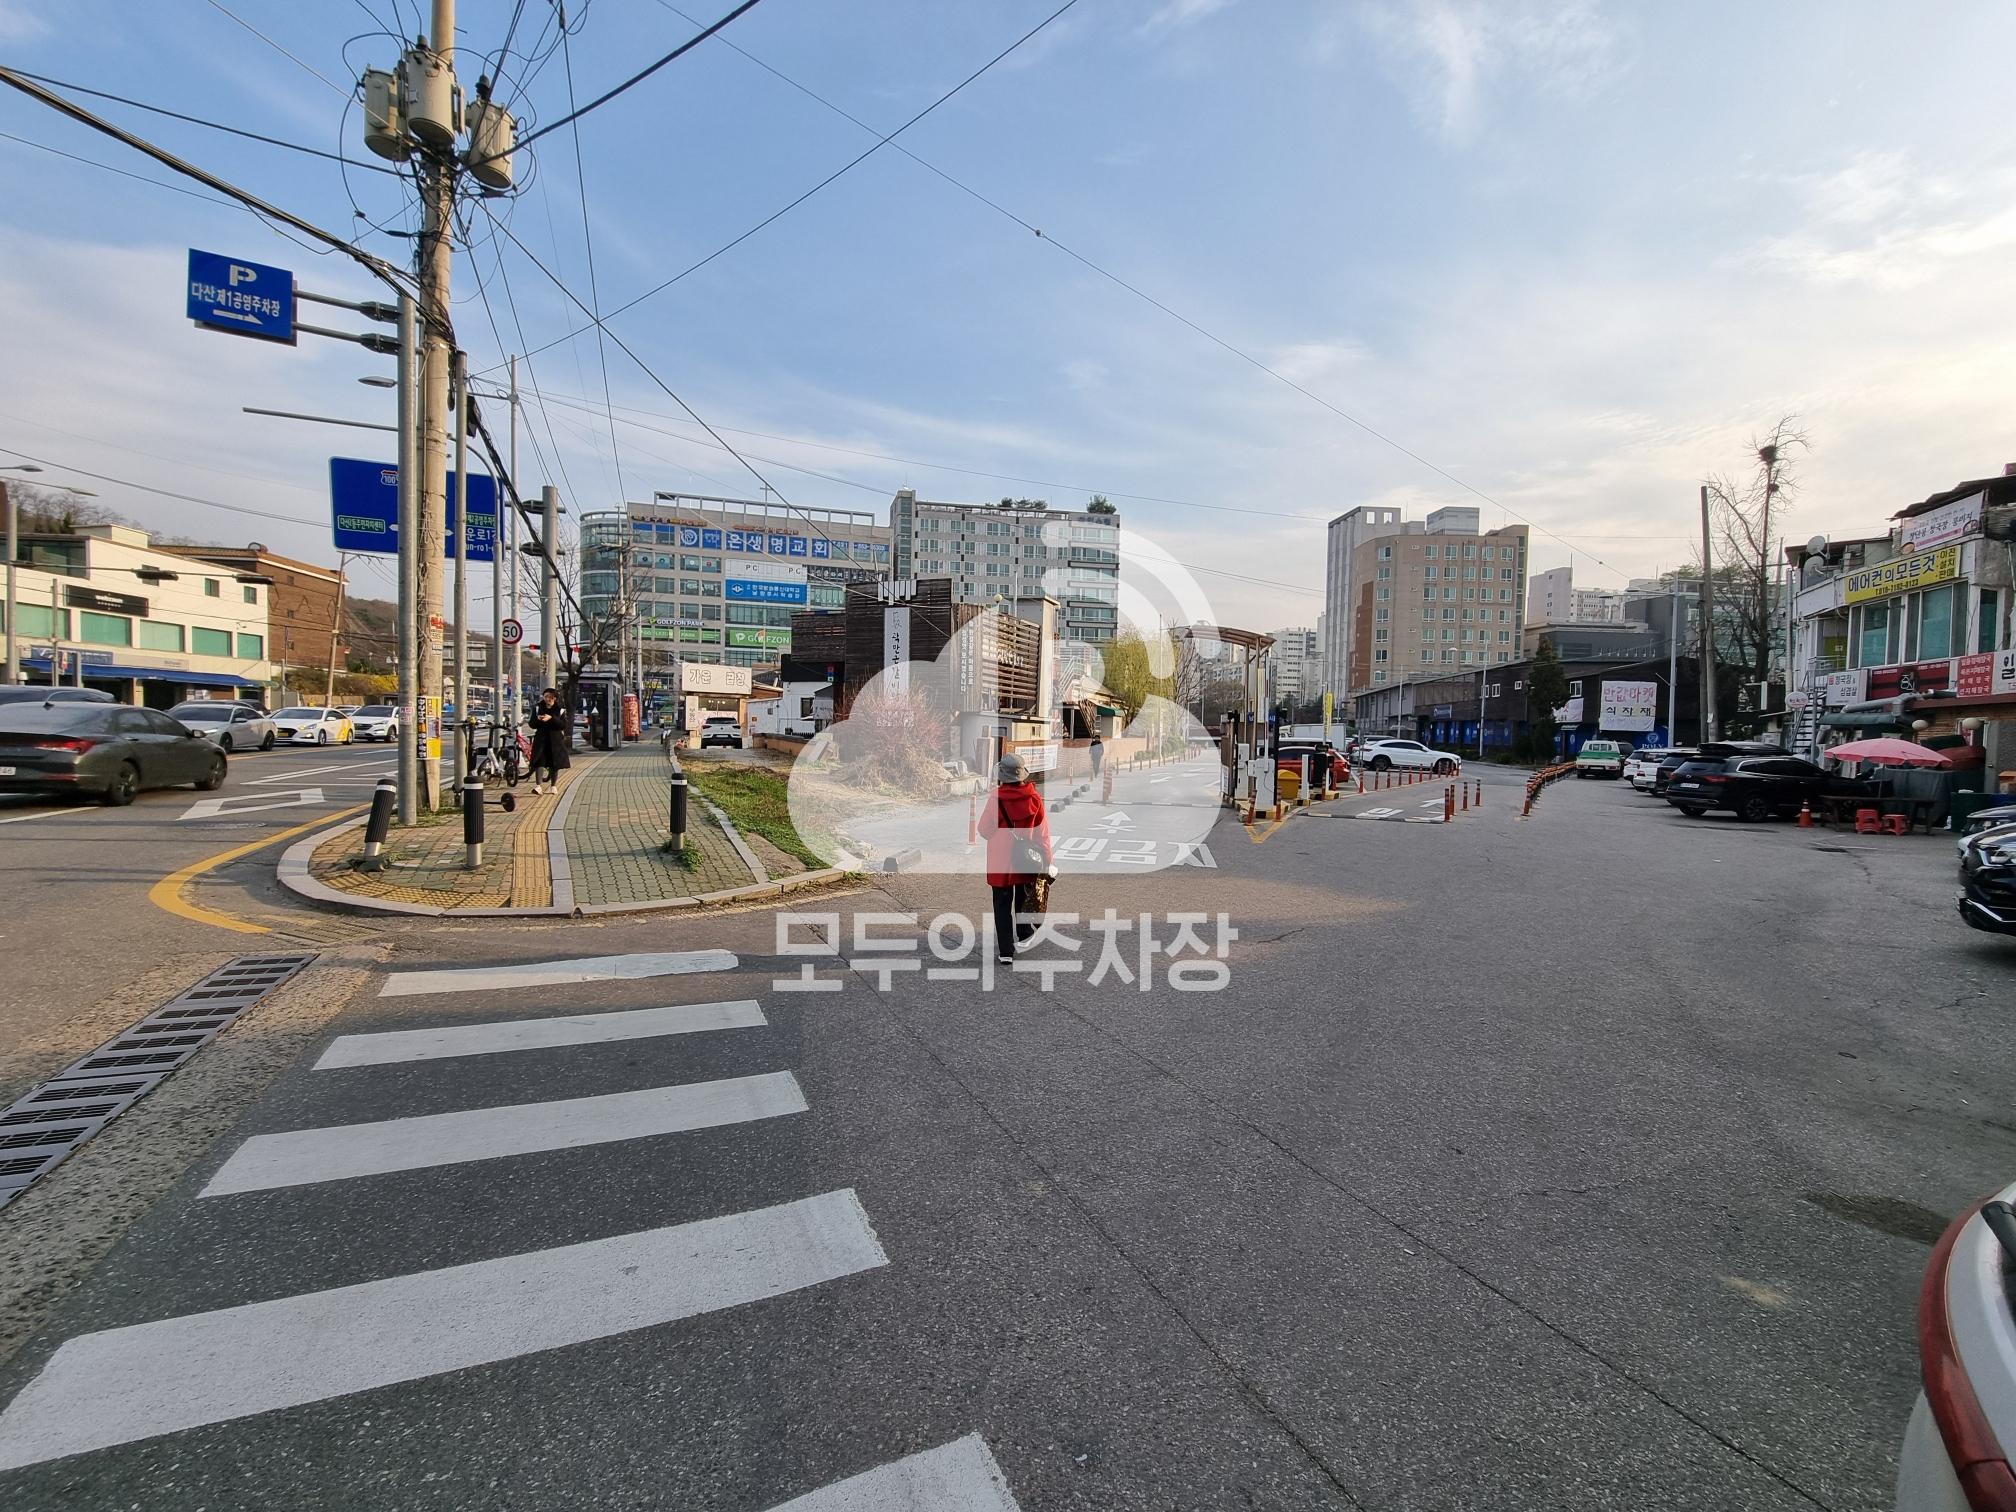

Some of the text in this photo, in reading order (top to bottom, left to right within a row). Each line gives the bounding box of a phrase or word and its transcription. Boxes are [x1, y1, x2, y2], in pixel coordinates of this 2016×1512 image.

[229, 264, 257, 286] P
[656, 619, 686, 627] GOLFZON
[503, 625, 518, 639] 50
[689, 669, 746, 687] 가운 곱창
[1840, 686, 1858, 697] 삼겹살
[1050, 836, 1218, 869] 입금지
